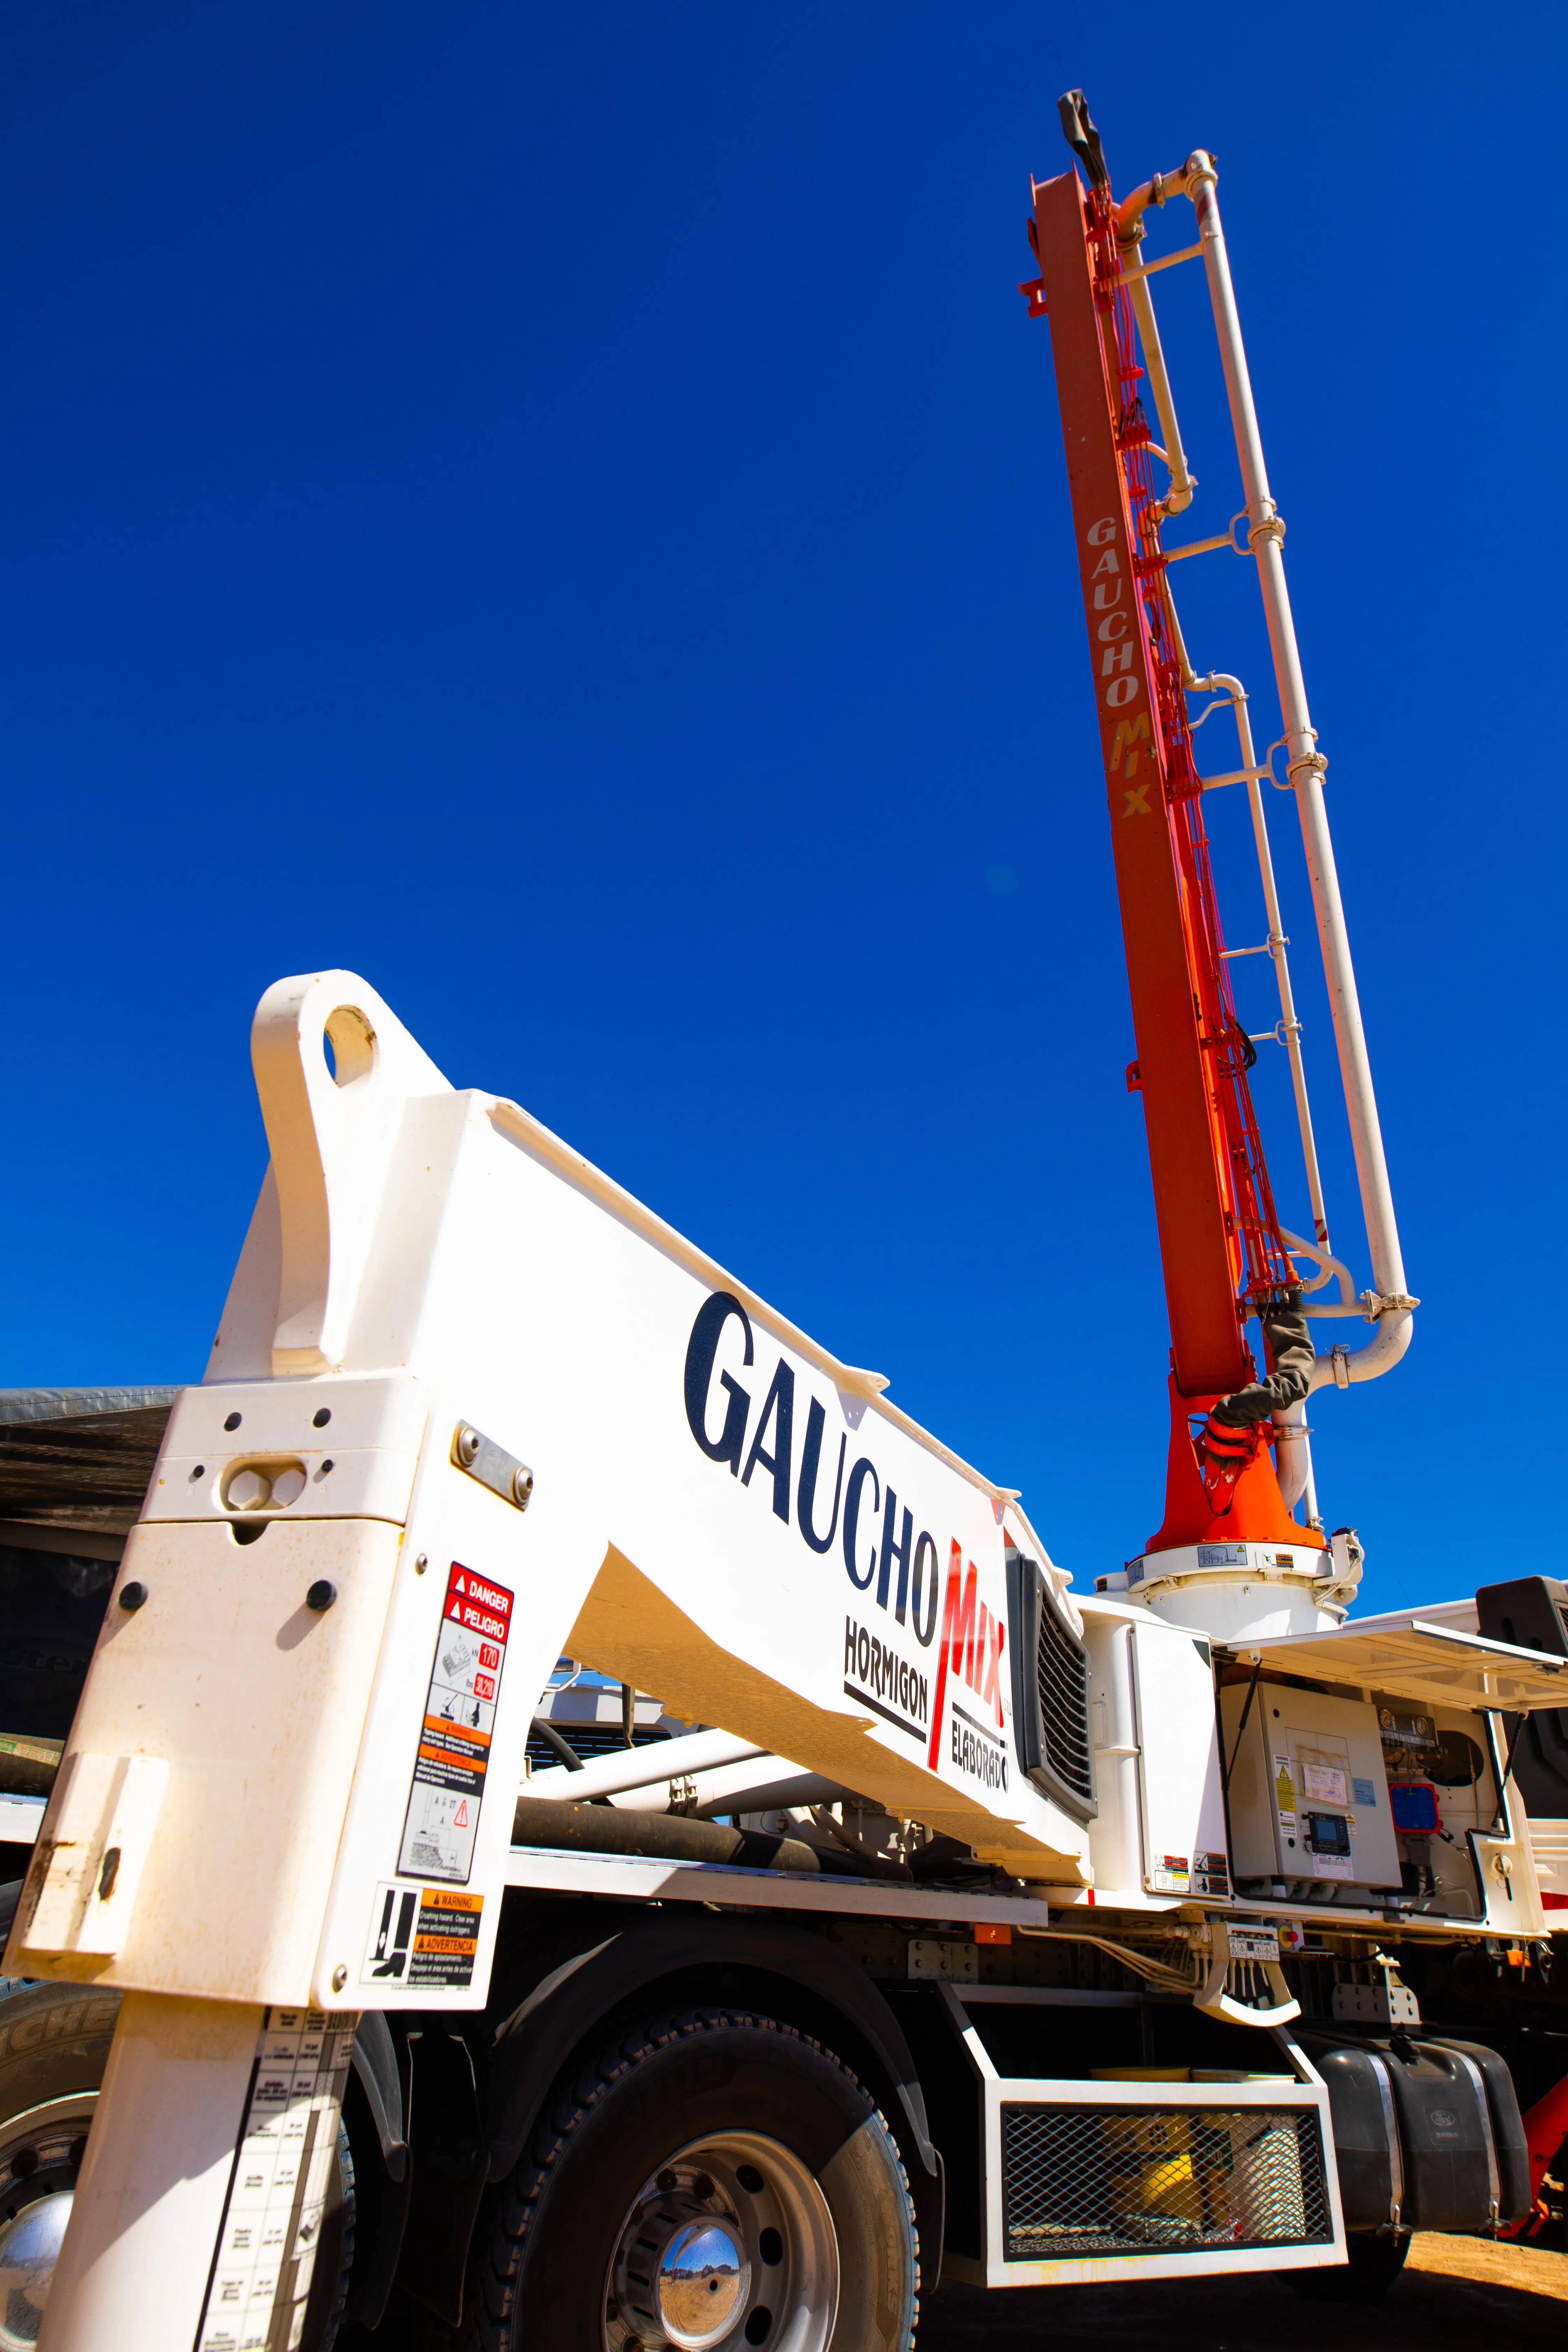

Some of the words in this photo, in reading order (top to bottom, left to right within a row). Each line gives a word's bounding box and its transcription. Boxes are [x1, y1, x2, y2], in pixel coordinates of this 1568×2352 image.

[1087, 517, 1138, 707] GAUCHO
[1108, 711, 1152, 819] MIX
[684, 1291, 938, 1647] GAUCHO
[927, 1536, 1005, 1774] MIX
[469, 1580, 508, 1613] DANGER
[464, 1607, 504, 1639] PELIGRO
[483, 1646, 497, 1667] 170
[844, 1615, 927, 1724] HORMIGON
[952, 1719, 1009, 1794] ELABORADO
[419, 1910, 439, 1922] Crushing
[455, 1914, 466, 1923] Clear
[442, 1895, 472, 1909] WARNING
[426, 1938, 472, 1952] ADVERTENCIA
[429, 1923, 450, 1935] activating
